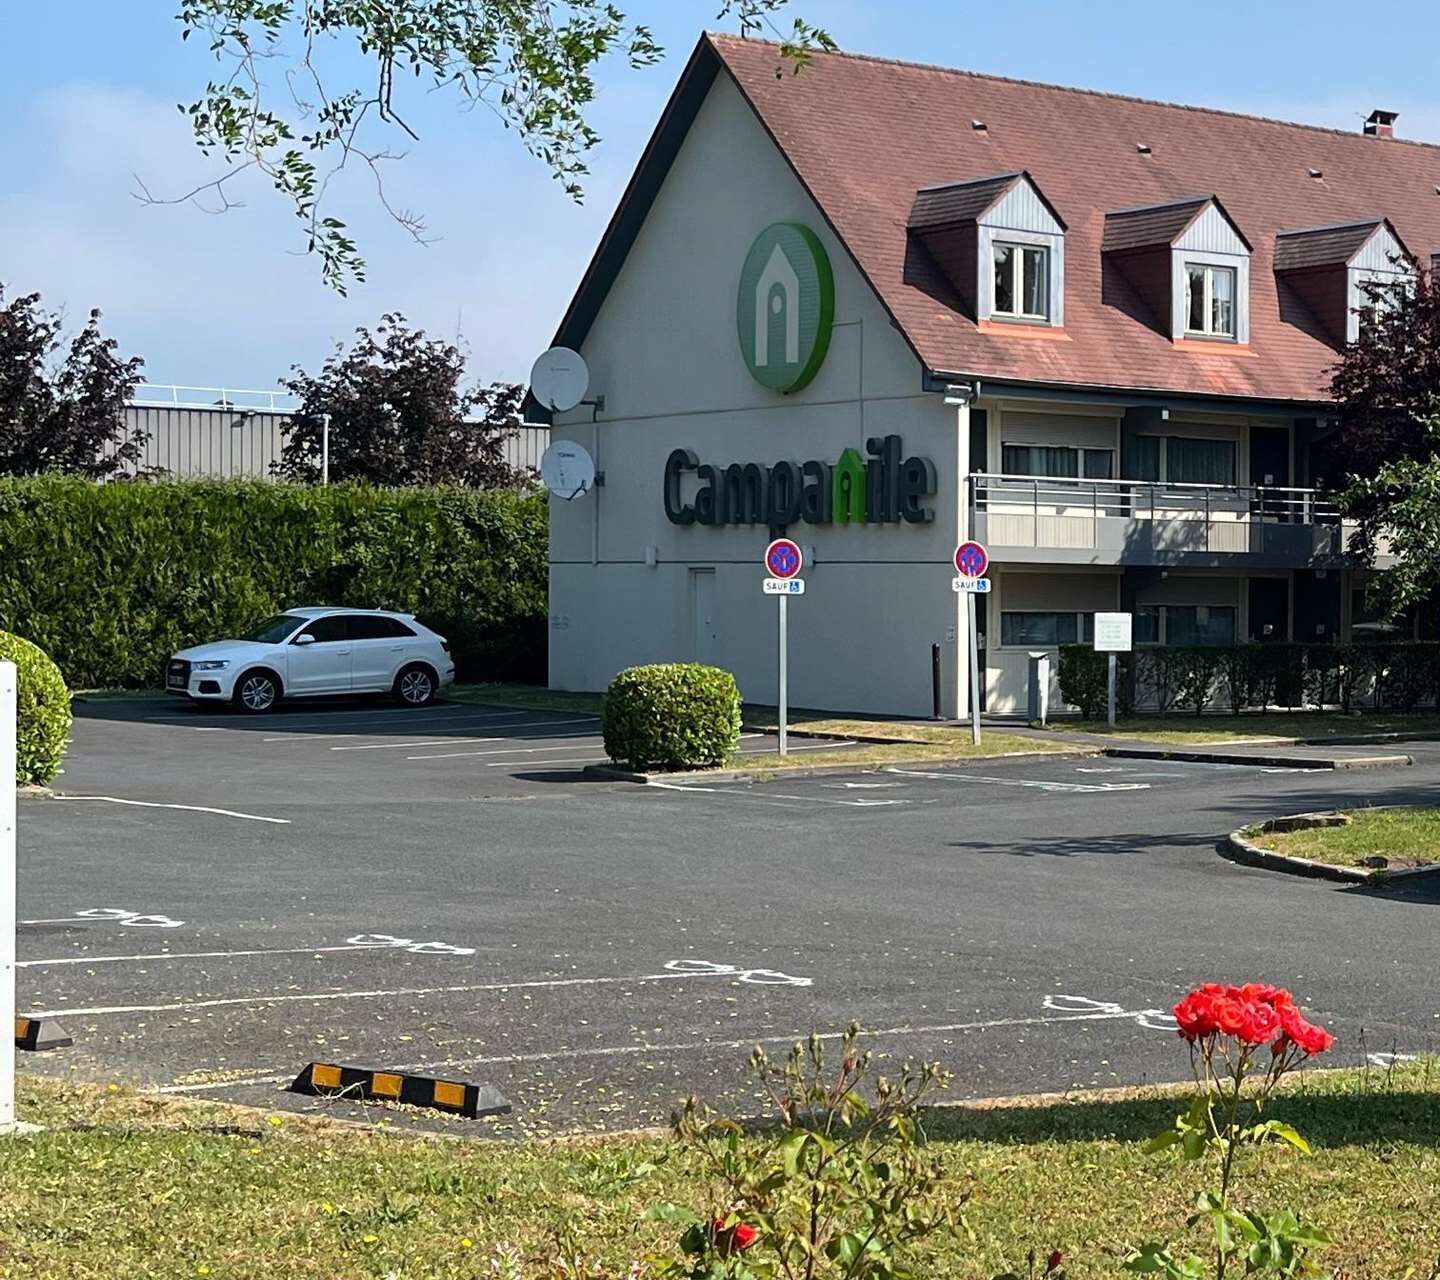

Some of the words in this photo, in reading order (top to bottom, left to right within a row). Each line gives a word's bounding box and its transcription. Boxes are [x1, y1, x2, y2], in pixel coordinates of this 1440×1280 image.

[664, 434, 937, 540] Campanile
[766, 582, 788, 591] SAUF
[955, 581, 976, 589] SAUF
